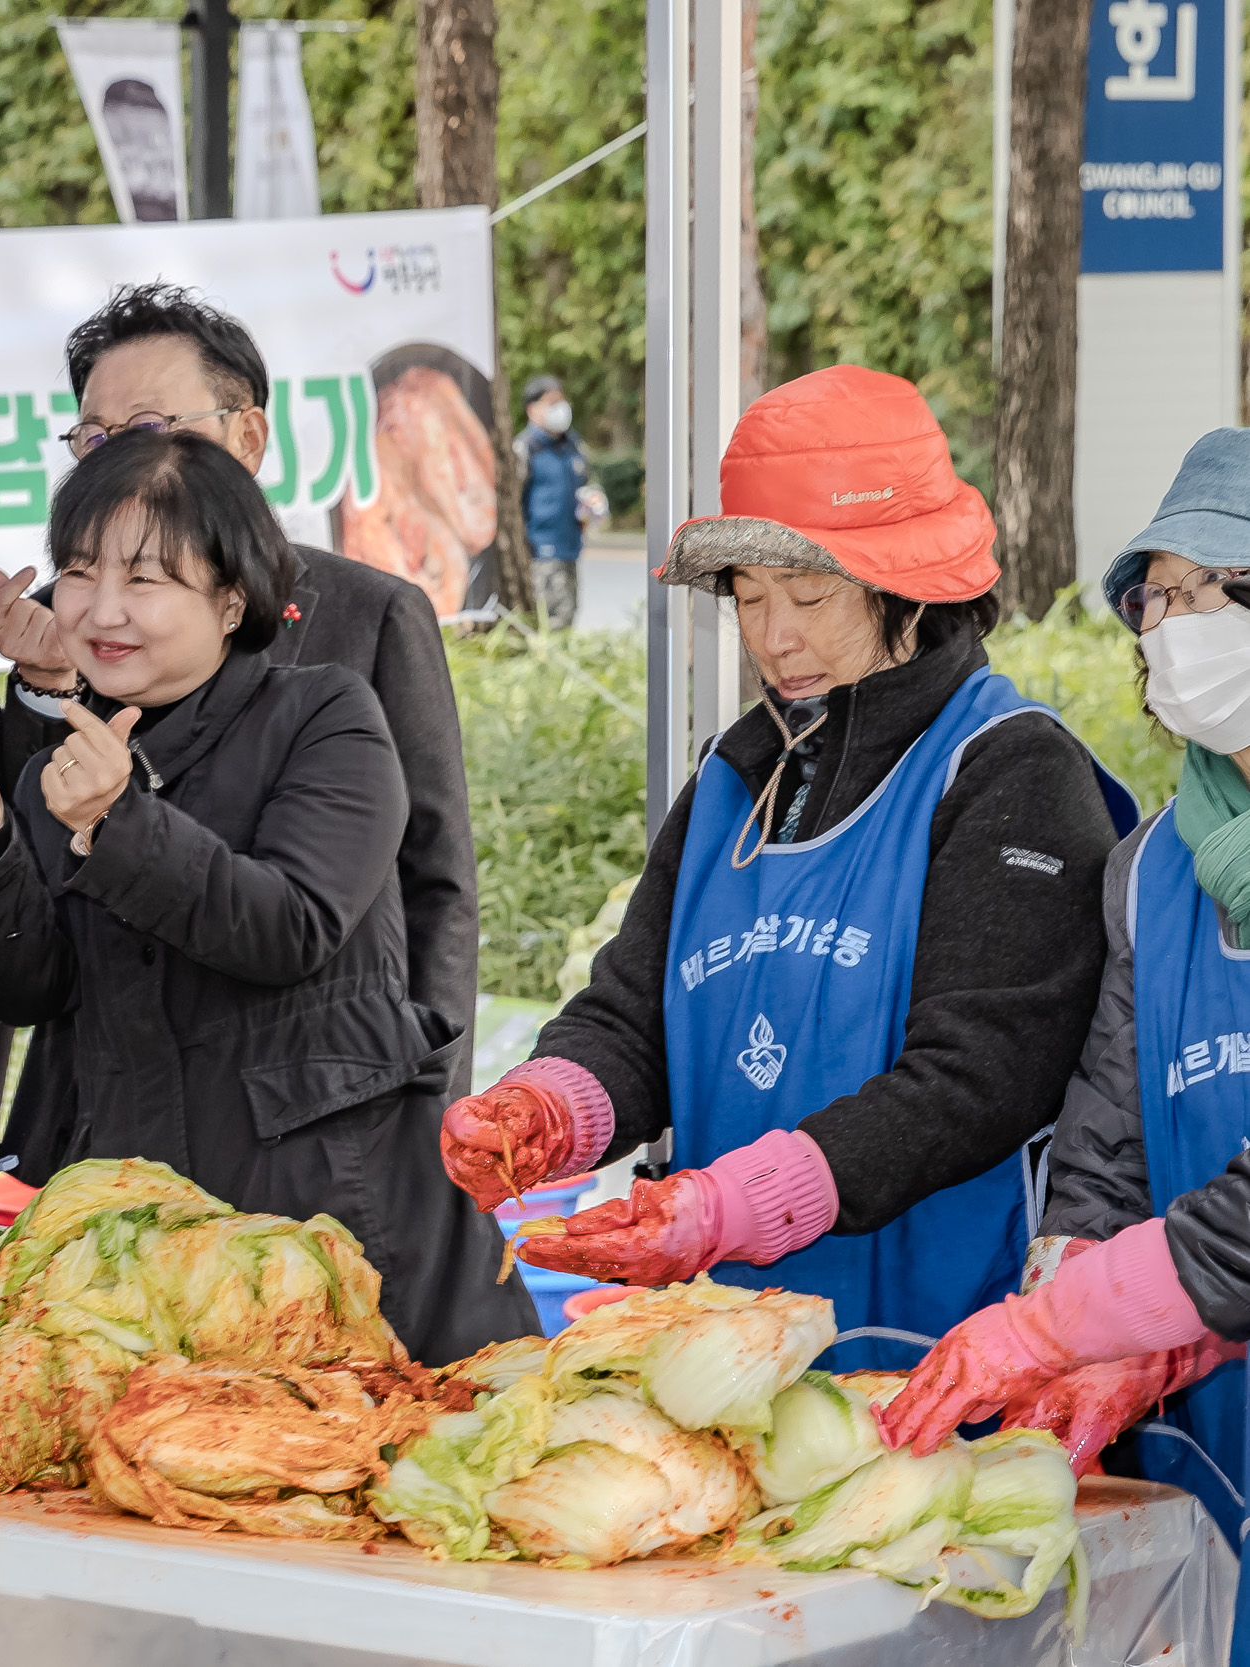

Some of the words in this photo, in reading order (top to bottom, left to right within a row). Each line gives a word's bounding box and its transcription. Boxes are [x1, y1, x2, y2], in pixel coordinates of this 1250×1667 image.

[1103, 0, 1197, 101] 회
[1102, 190, 1196, 219] COUNCIL
[831, 490, 882, 506] Lafuma
